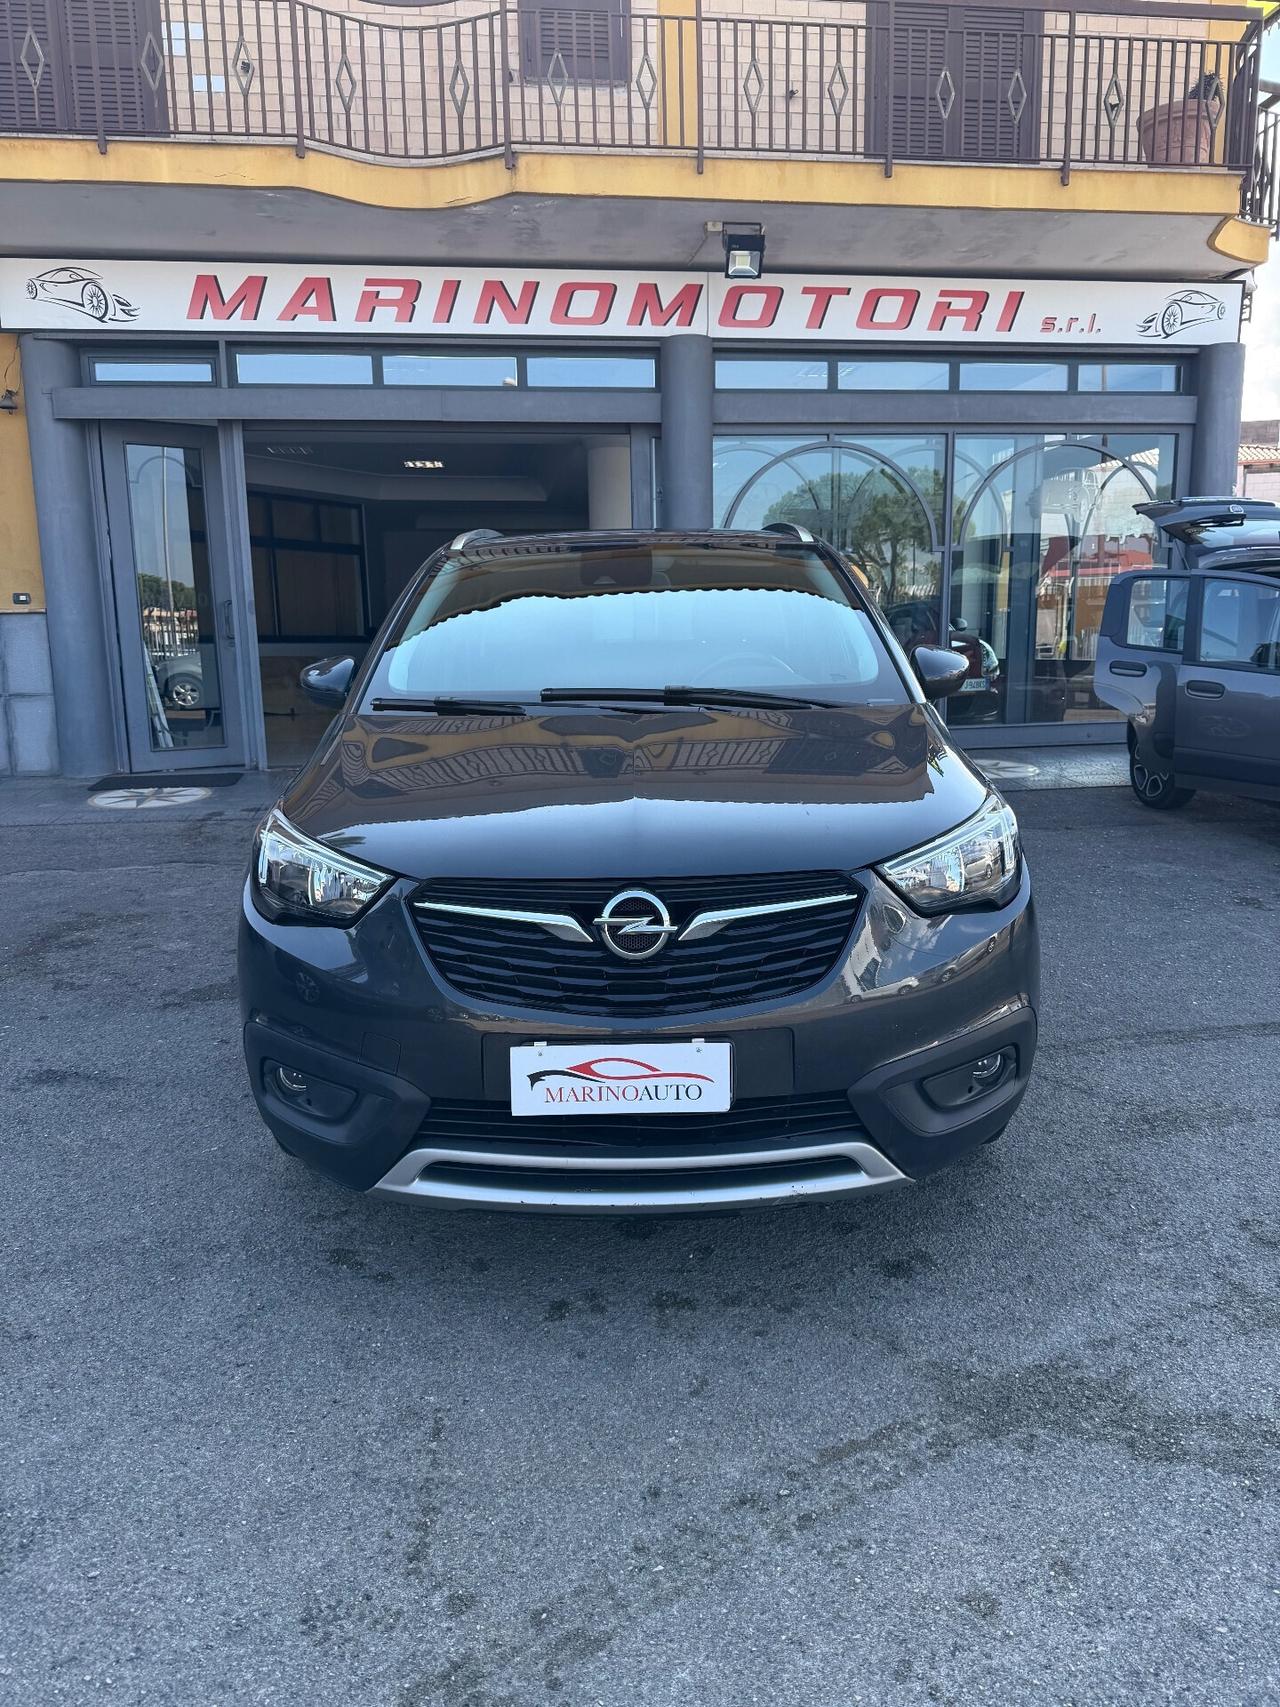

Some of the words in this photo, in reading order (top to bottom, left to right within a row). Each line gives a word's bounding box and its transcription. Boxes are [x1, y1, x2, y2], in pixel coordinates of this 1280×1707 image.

[186, 274, 1025, 333] MARINOMOTORI
[1040, 313, 1102, 334] s.r.l.
[544, 1083, 703, 1103] MARINOAUTO
